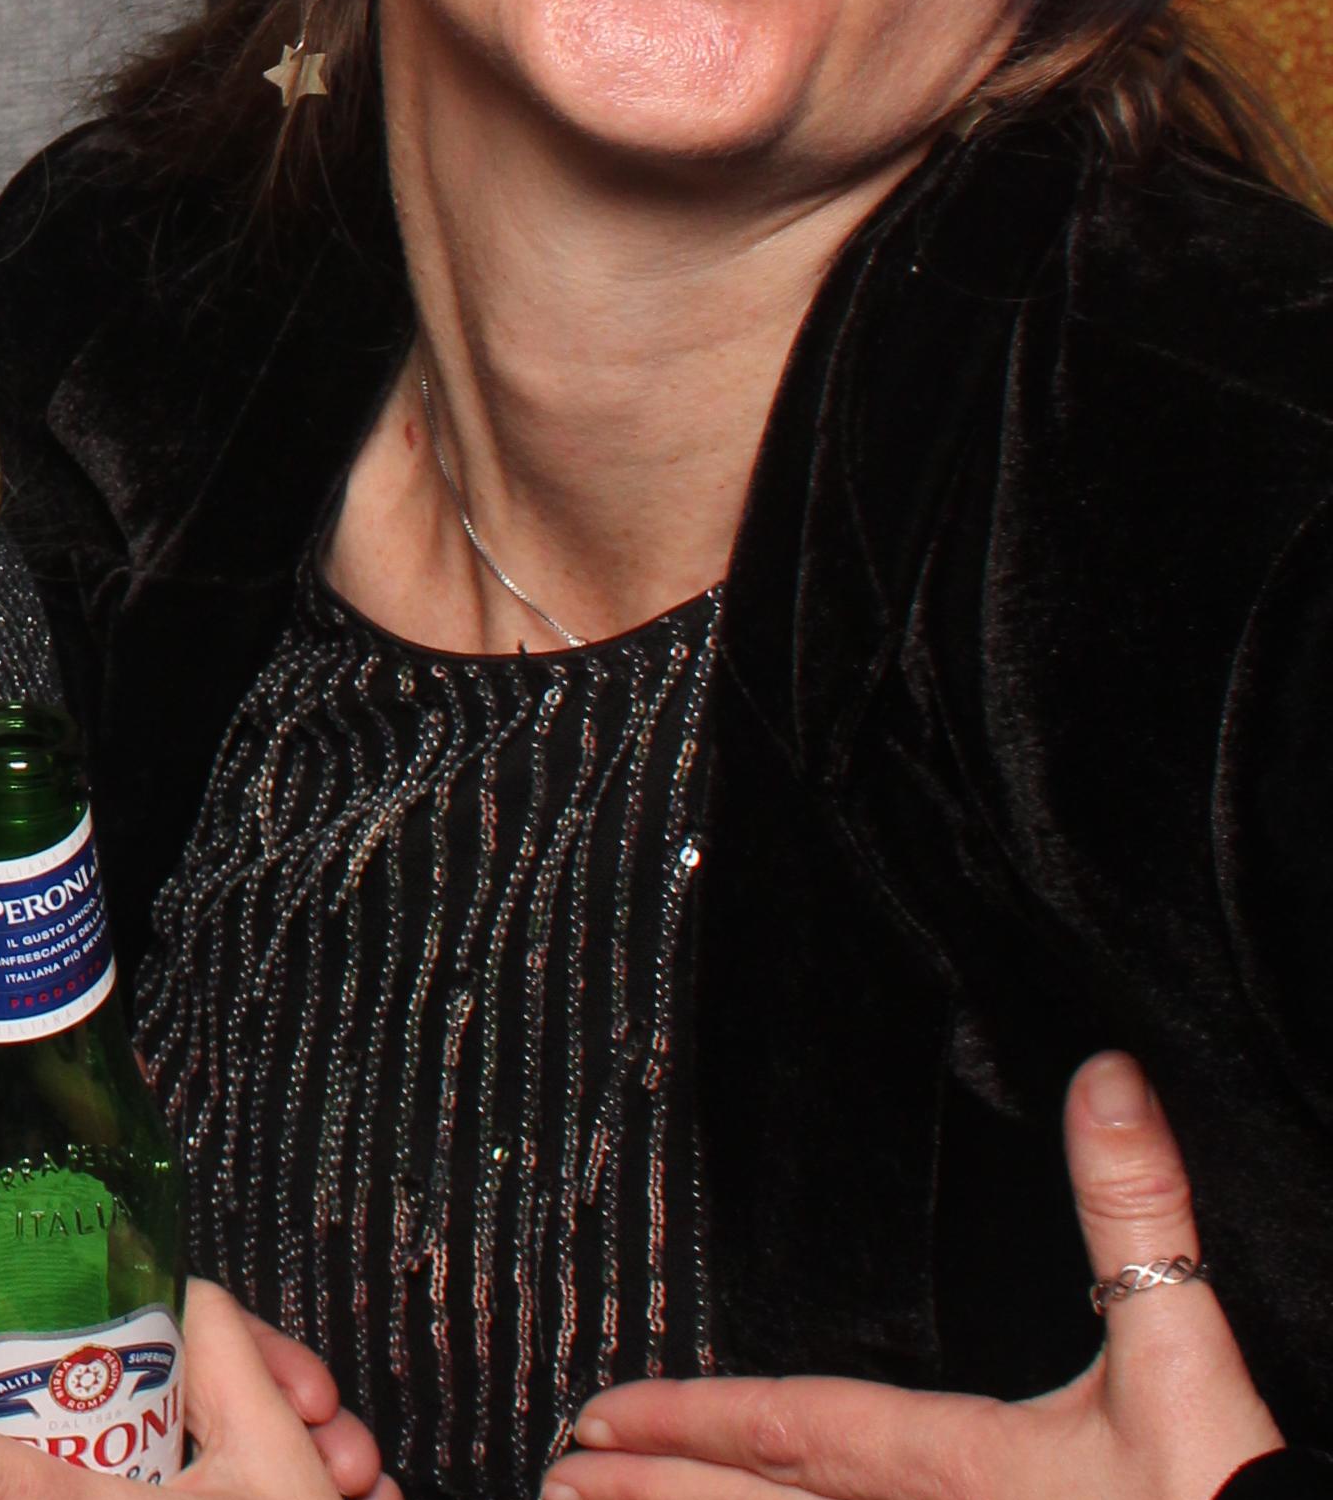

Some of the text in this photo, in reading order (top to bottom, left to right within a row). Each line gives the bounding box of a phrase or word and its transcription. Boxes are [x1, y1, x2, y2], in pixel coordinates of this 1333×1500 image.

[6, 938, 19, 949] IL
[22, 923, 65, 946] GUSTO
[4, 962, 61, 985] ITALIANA
[63, 949, 81, 967] PIÙ
[15, 1195, 132, 1238] ITALIA
[52, 1361, 72, 1399] BIRRA
[67, 1394, 107, 1410] ROMA
